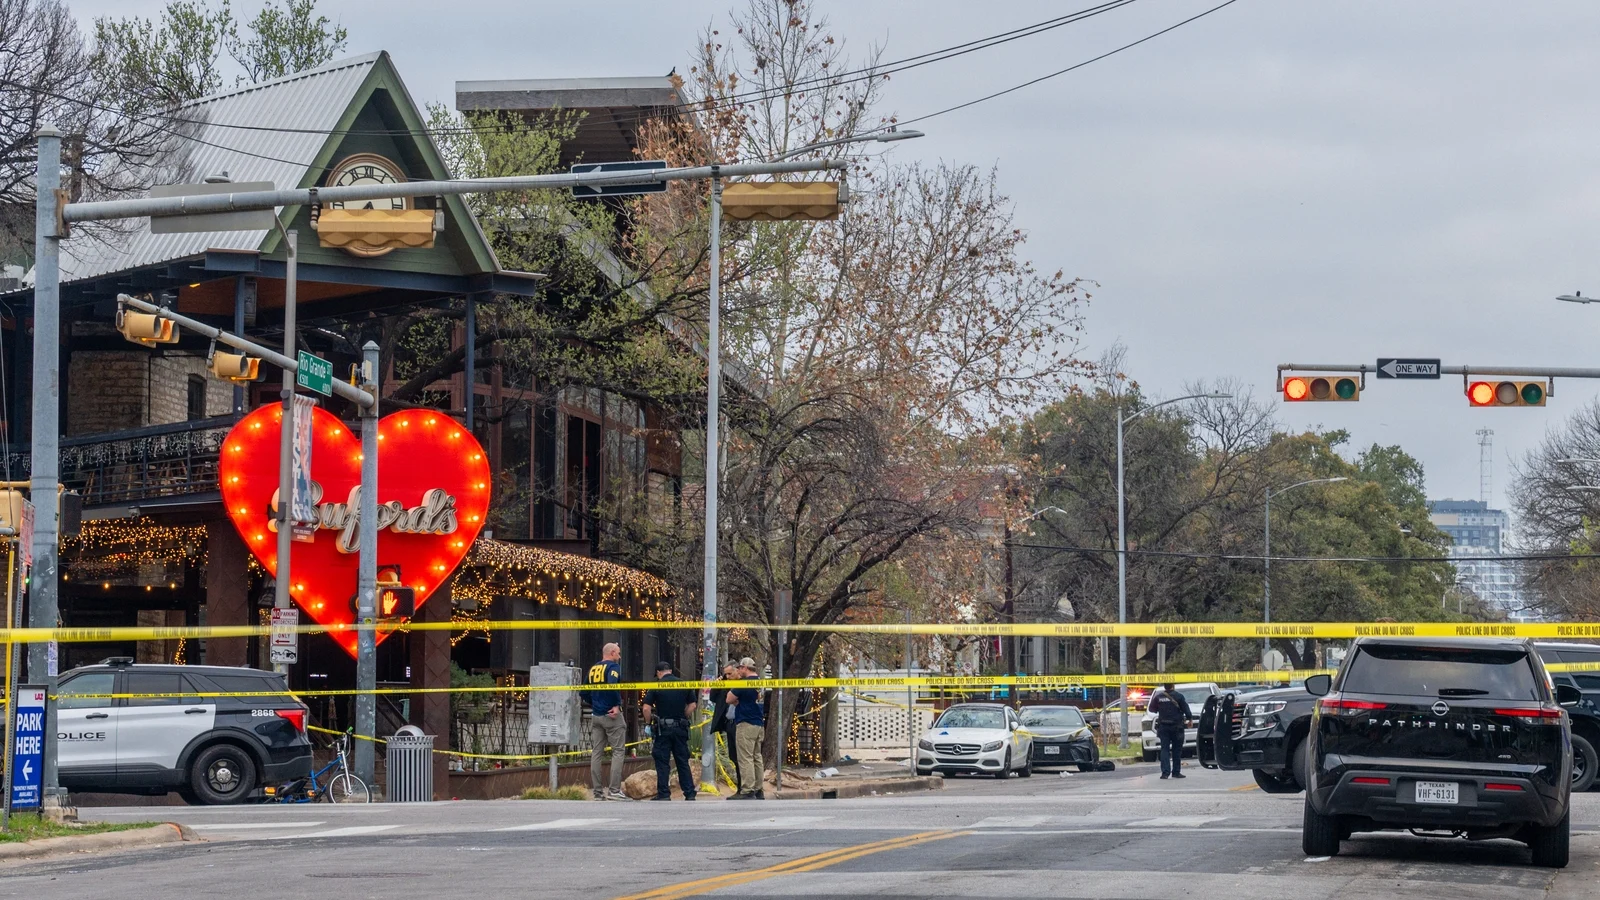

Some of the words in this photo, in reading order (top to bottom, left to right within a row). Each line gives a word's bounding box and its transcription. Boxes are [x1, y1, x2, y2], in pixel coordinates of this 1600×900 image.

[300, 353, 309, 372] Rio
[310, 357, 327, 379] Grande
[1396, 365, 1412, 373] ONE
[1416, 365, 1433, 373] WAY
[273, 610, 281, 618] NO
[1155, 626, 1170, 634] POLICE
[1172, 626, 1182, 634] LINE
[1182, 626, 1189, 634] DO
[1190, 626, 1199, 634] NOT
[1200, 626, 1214, 634] CROSS
[1256, 626, 1270, 635] POLICE
[1271, 626, 1281, 635] LINE
[1282, 626, 1288, 635] DO
[1289, 626, 1298, 635] NOT
[1299, 626, 1314, 635] CROSS
[1355, 626, 1370, 635] POLICE
[1372, 626, 1381, 635] LINE
[1382, 626, 1388, 635] DO
[1389, 626, 1399, 635] NOT
[1400, 626, 1414, 635] CROSS
[1456, 626, 1471, 636] POLICE
[1472, 626, 1482, 636] LINE
[1483, 626, 1490, 636] DO
[1490, 626, 1500, 636] NOT
[1501, 626, 1516, 636] CROSS
[1558, 626, 1573, 636] POLICE
[1574, 626, 1584, 636] LINE
[1584, 626, 1591, 636] DO
[588, 664, 608, 684] FBI
[251, 709, 275, 717] 2868
[16, 712, 43, 732] PARK
[1369, 719, 1511, 732] PATHFINDER
[57, 731, 106, 740] OLICE
[15, 736, 41, 755] HERE
